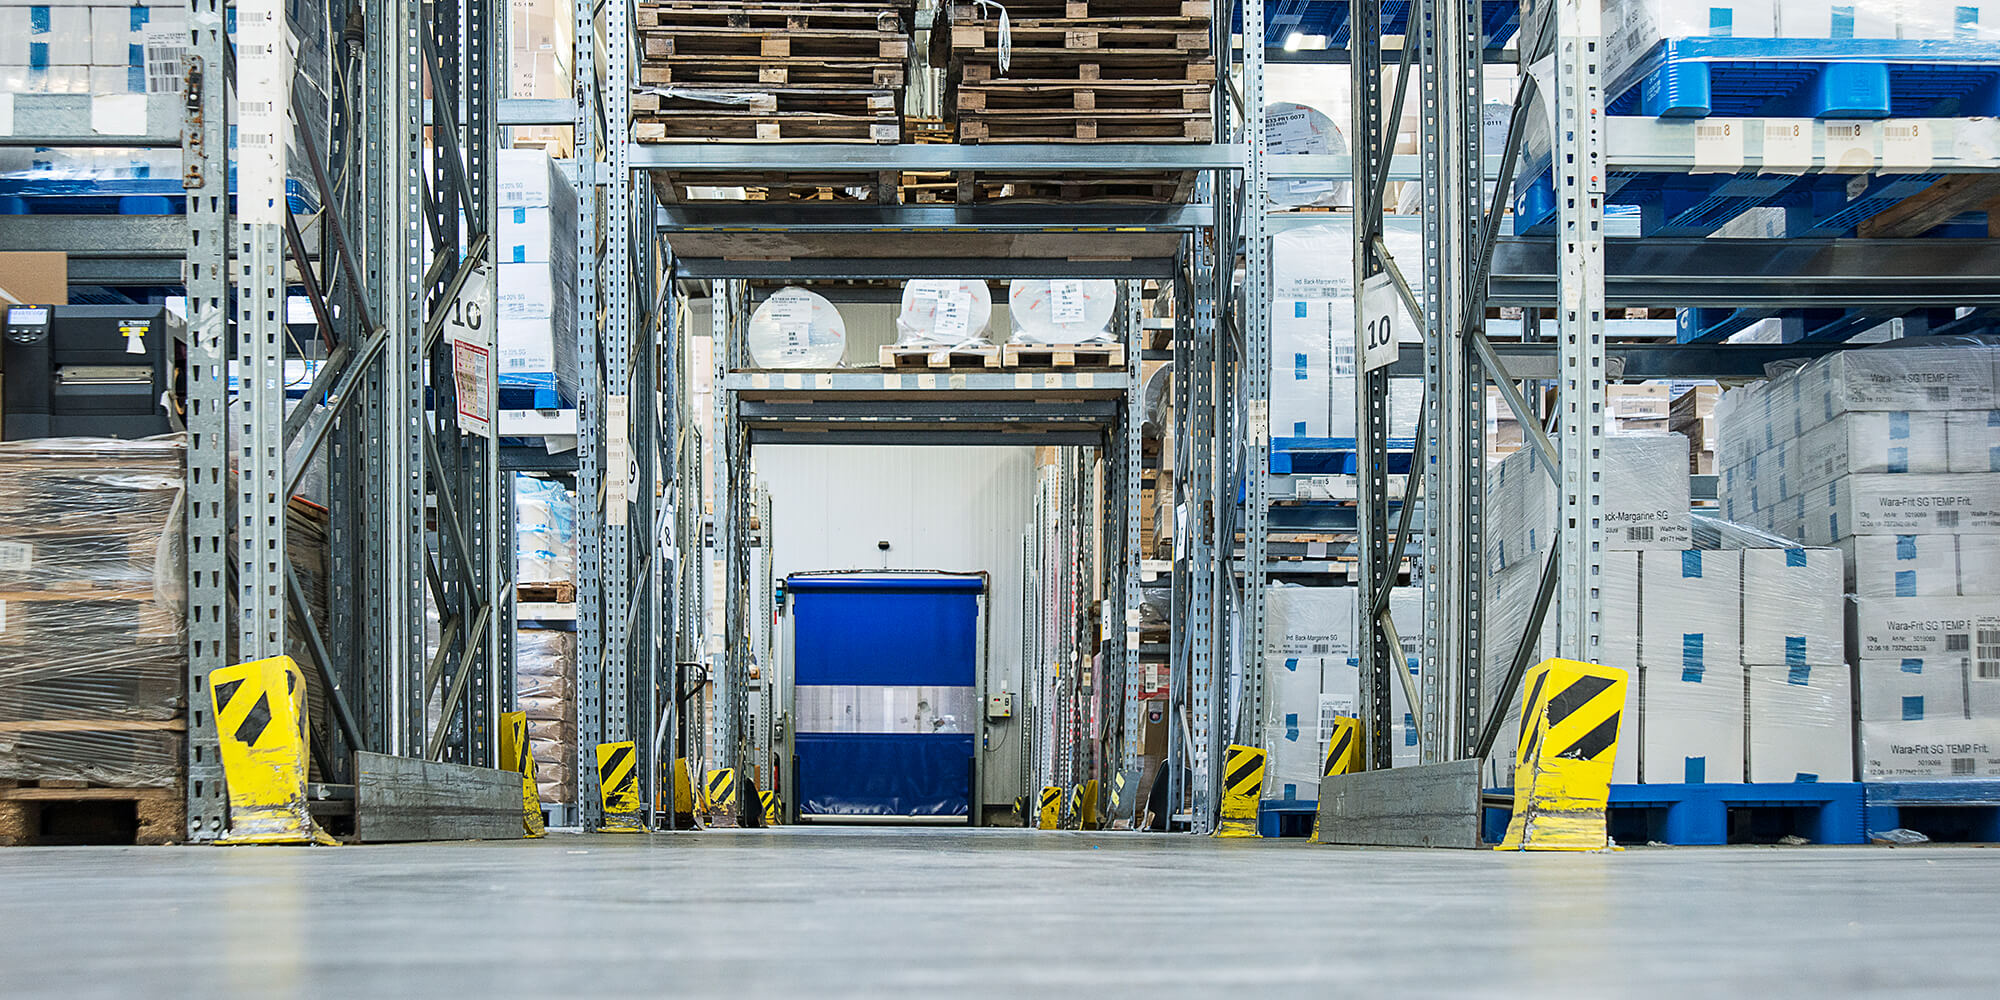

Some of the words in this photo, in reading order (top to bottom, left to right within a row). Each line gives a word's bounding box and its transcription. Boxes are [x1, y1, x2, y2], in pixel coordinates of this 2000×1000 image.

[266, 10, 272, 22] 4
[267, 43, 273, 55] 4
[268, 101, 273, 113] 1
[1724, 123, 1730, 136] 8
[1793, 124, 1799, 137] 8
[1854, 124, 1861, 136] 8
[1912, 125, 1918, 137] 8
[268, 132, 274, 145] 1
[452, 297, 482, 331] 10
[1367, 315, 1391, 350] 10
[1907, 373, 1920, 384] SG
[1922, 372, 1945, 383] TEMP
[629, 460, 636, 484] 9
[1879, 497, 1915, 507] Wara-Frit
[1916, 496, 1929, 507] SG
[1931, 496, 1955, 507] TEMP
[1604, 511, 1654, 523] ack-Margarine
[1656, 510, 1668, 520] SG
[664, 526, 671, 547] 8
[1887, 620, 1923, 630] Wara-Frit
[1925, 620, 1938, 631] SG
[1941, 620, 1965, 630] TEMP
[1891, 745, 1929, 754] Wara-Frit
[1930, 744, 1943, 754] SG
[1946, 744, 1971, 754] TEMP
